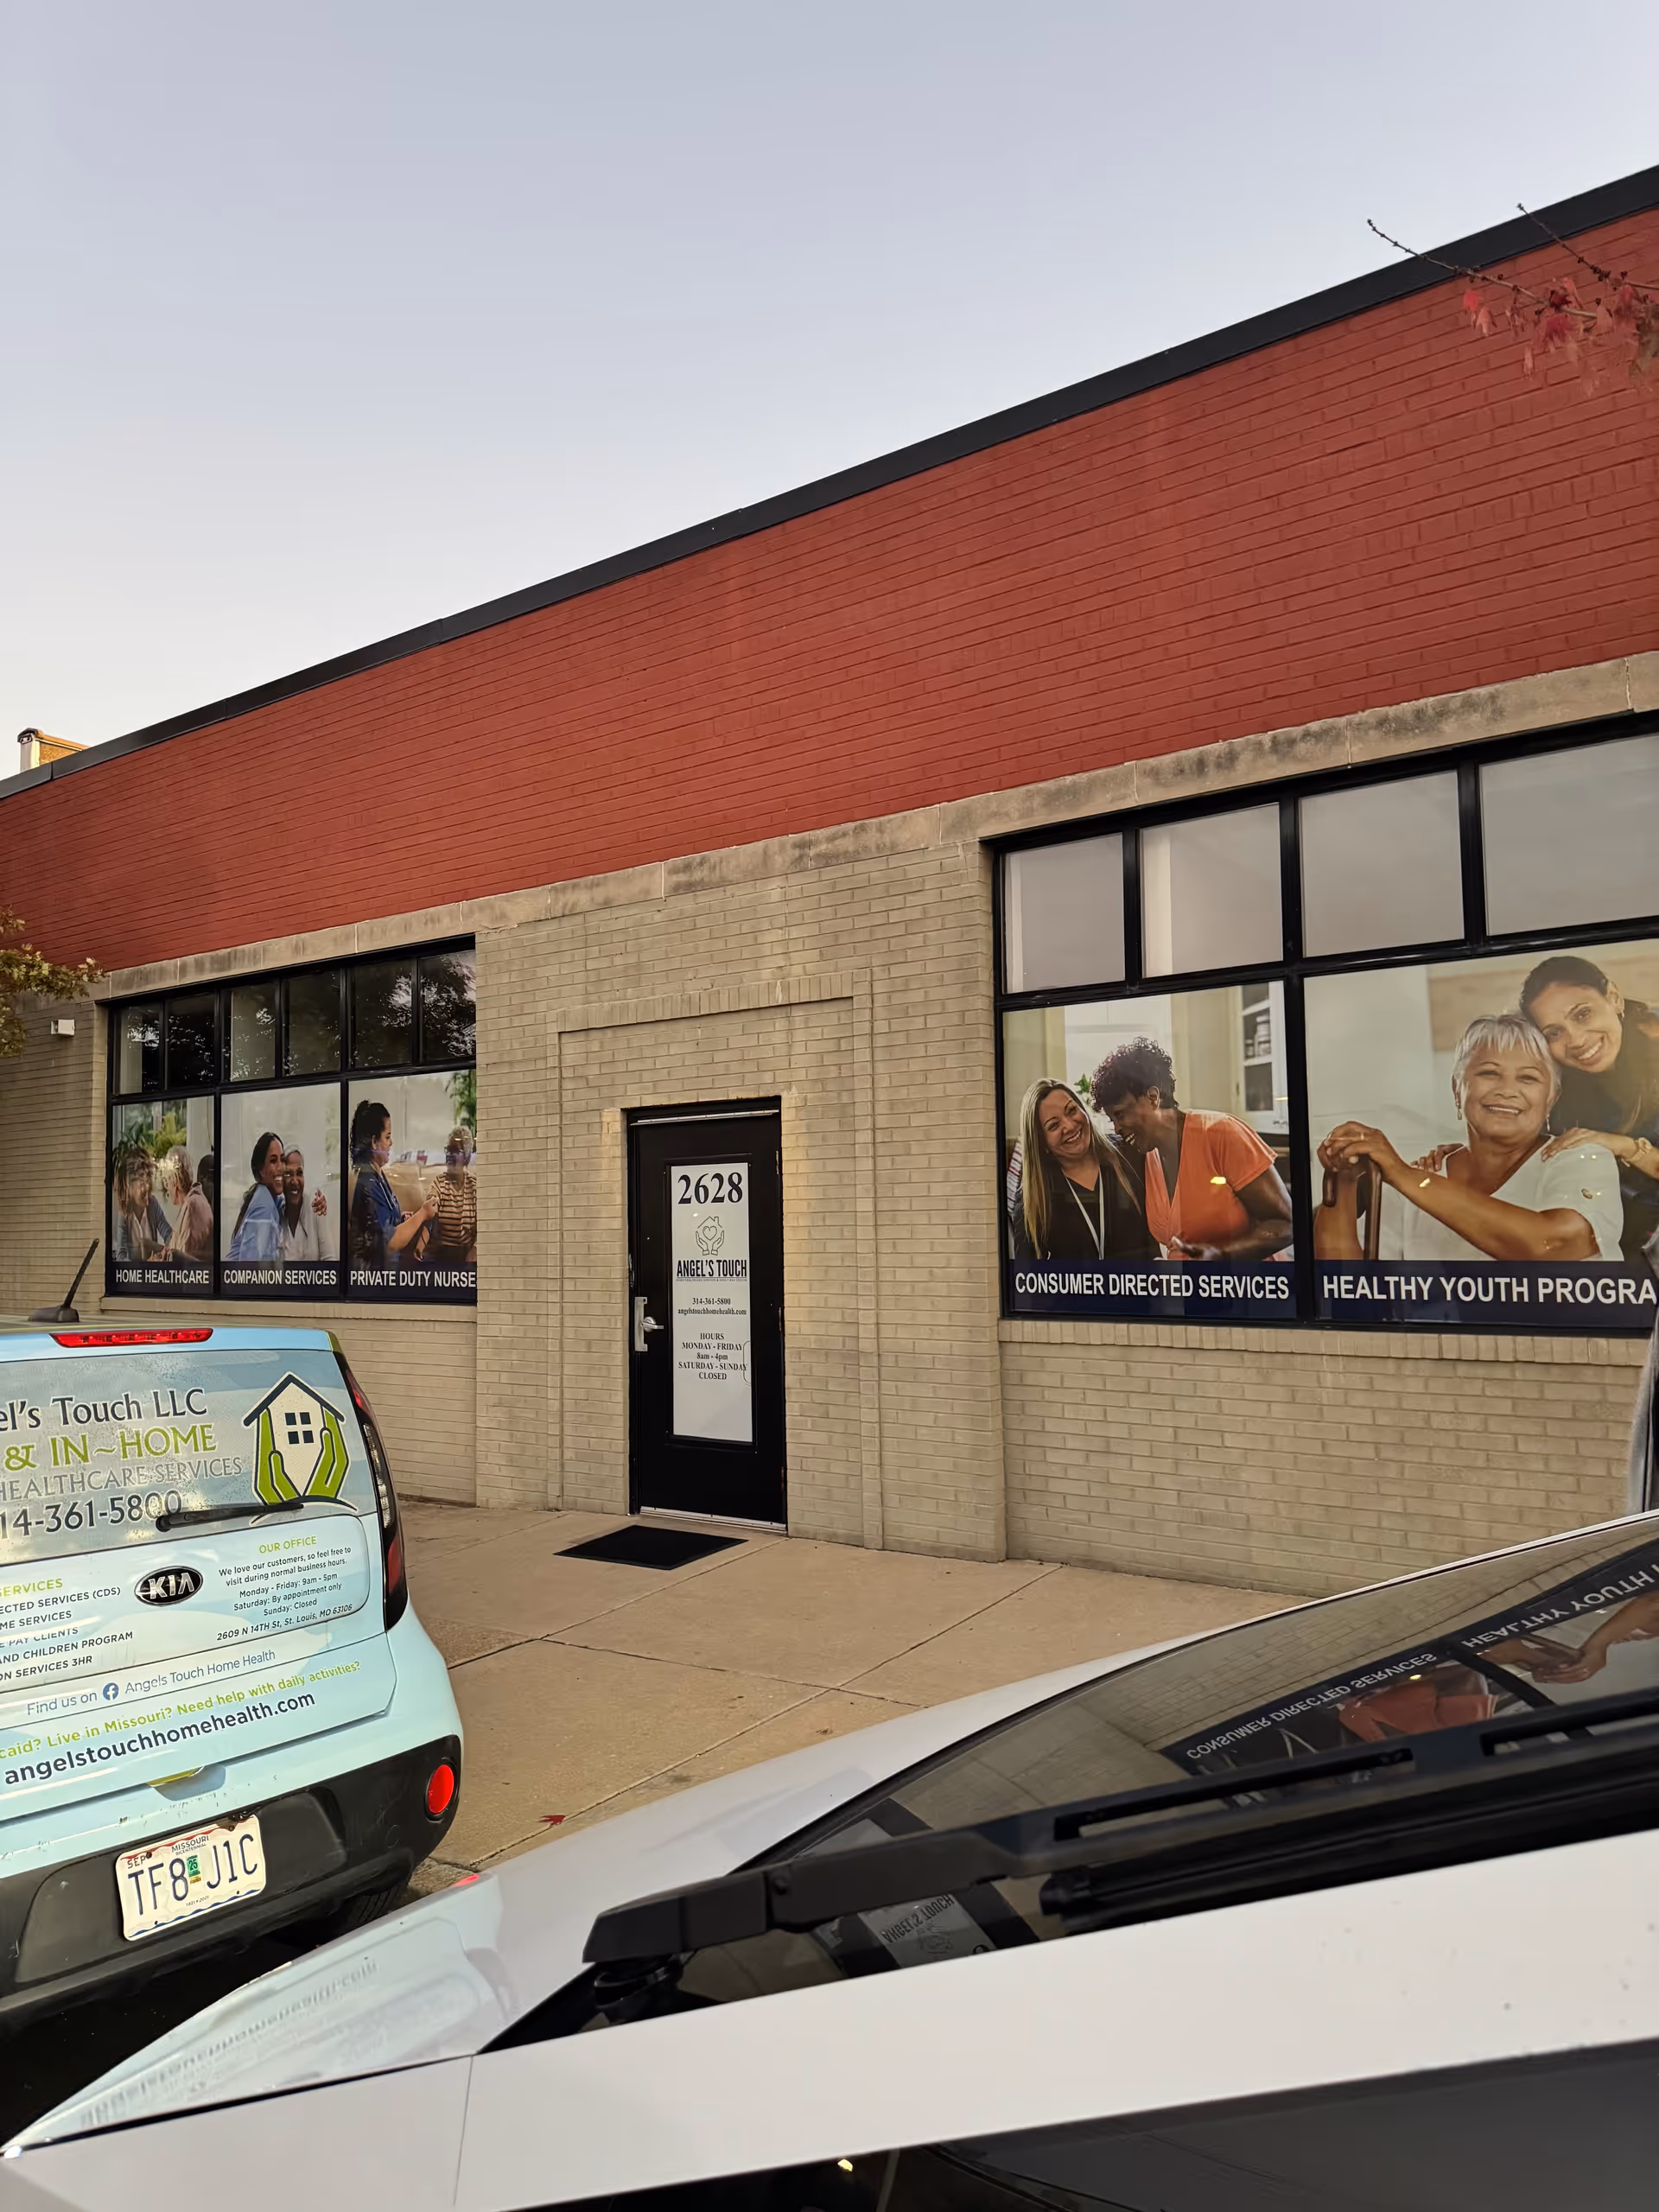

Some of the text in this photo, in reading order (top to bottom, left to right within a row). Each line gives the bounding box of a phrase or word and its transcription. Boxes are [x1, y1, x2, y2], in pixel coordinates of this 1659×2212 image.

[677, 1172, 743, 1205] 2628
[116, 1270, 209, 1284] HOME HEALTHCARE
[224, 1269, 337, 1285] COMPANION SERVICES
[350, 1271, 476, 1287] PRIVATE DUTY NURSE
[677, 1260, 747, 1277] ANGEL'S TOUCH
[1015, 1273, 1289, 1299] CONSUMER DIRECTED SERVICES
[1323, 1275, 1433, 1300] HEALTHY
[1440, 1276, 1528, 1303] YOUTH
[677, 1307, 747, 1316] angelstouchhomehealth.com
[715, 1353, 728, 1362] 4pm
[52, 1394, 142, 1425] Touch
[153, 1389, 207, 1417] LLC
[4, 1444, 36, 1471] &
[156, 1456, 242, 1483] SERVICES
[259, 1536, 317, 1554] OUR OFFICE
[219, 1567, 232, 1577] We
[234, 1565, 251, 1574] love
[267, 1554, 306, 1567] customers,
[307, 1552, 315, 1560] so
[317, 1549, 329, 1559] feel
[330, 1548, 343, 1556] free
[226, 1559, 347, 1586] visit during normal business hours.
[38, 1592, 90, 1608] SERVICES
[92, 1586, 121, 1599] (CDS)
[233, 1582, 342, 1611] Saturday: By appointment only
[239, 1586, 269, 1599] Monday
[276, 1580, 301, 1591] Friday:
[302, 1577, 317, 1586] 9am
[323, 1573, 338, 1582] 5pm
[19, 1611, 72, 1627] SERVICES
[264, 1599, 317, 1616] Sunday: Closed
[217, 1630, 239, 1641] 2609
[251, 1622, 270, 1633] 14TH
[271, 1620, 283, 1629] St,
[296, 1612, 318, 1624] Louis,
[320, 1609, 332, 1618] MO
[332, 1604, 353, 1615] 63106
[23, 1643, 79, 1660] CHILDREN
[81, 1630, 133, 1649] PROGRAM
[16, 1660, 68, 1678] SERVICES
[72, 1656, 92, 1667] 3HR
[27, 1697, 58, 1716] Find
[60, 1696, 77, 1708] us
[80, 1691, 98, 1704] on
[124, 1675, 168, 1694] Angels
[169, 1666, 205, 1682] Touch
[207, 1658, 240, 1675] Home
[243, 1649, 276, 1667] Health
[47, 1731, 81, 1748] Live
[85, 1726, 100, 1739] in
[104, 1707, 172, 1733] Missouri?
[176, 1697, 213, 1715] Need
[216, 1690, 245, 1707] help
[248, 1682, 275, 1698] with
[278, 1675, 305, 1690] daily
[309, 1661, 360, 1682] activities?
[4, 1692, 315, 1784] angelstouchhomehealth.com
[171, 1835, 210, 1853] MISSOURI
[127, 1856, 146, 1869] SEP
[128, 1858, 189, 1916] TF8
[207, 1834, 257, 1890] J1C
[188, 1858, 198, 1871] 25
